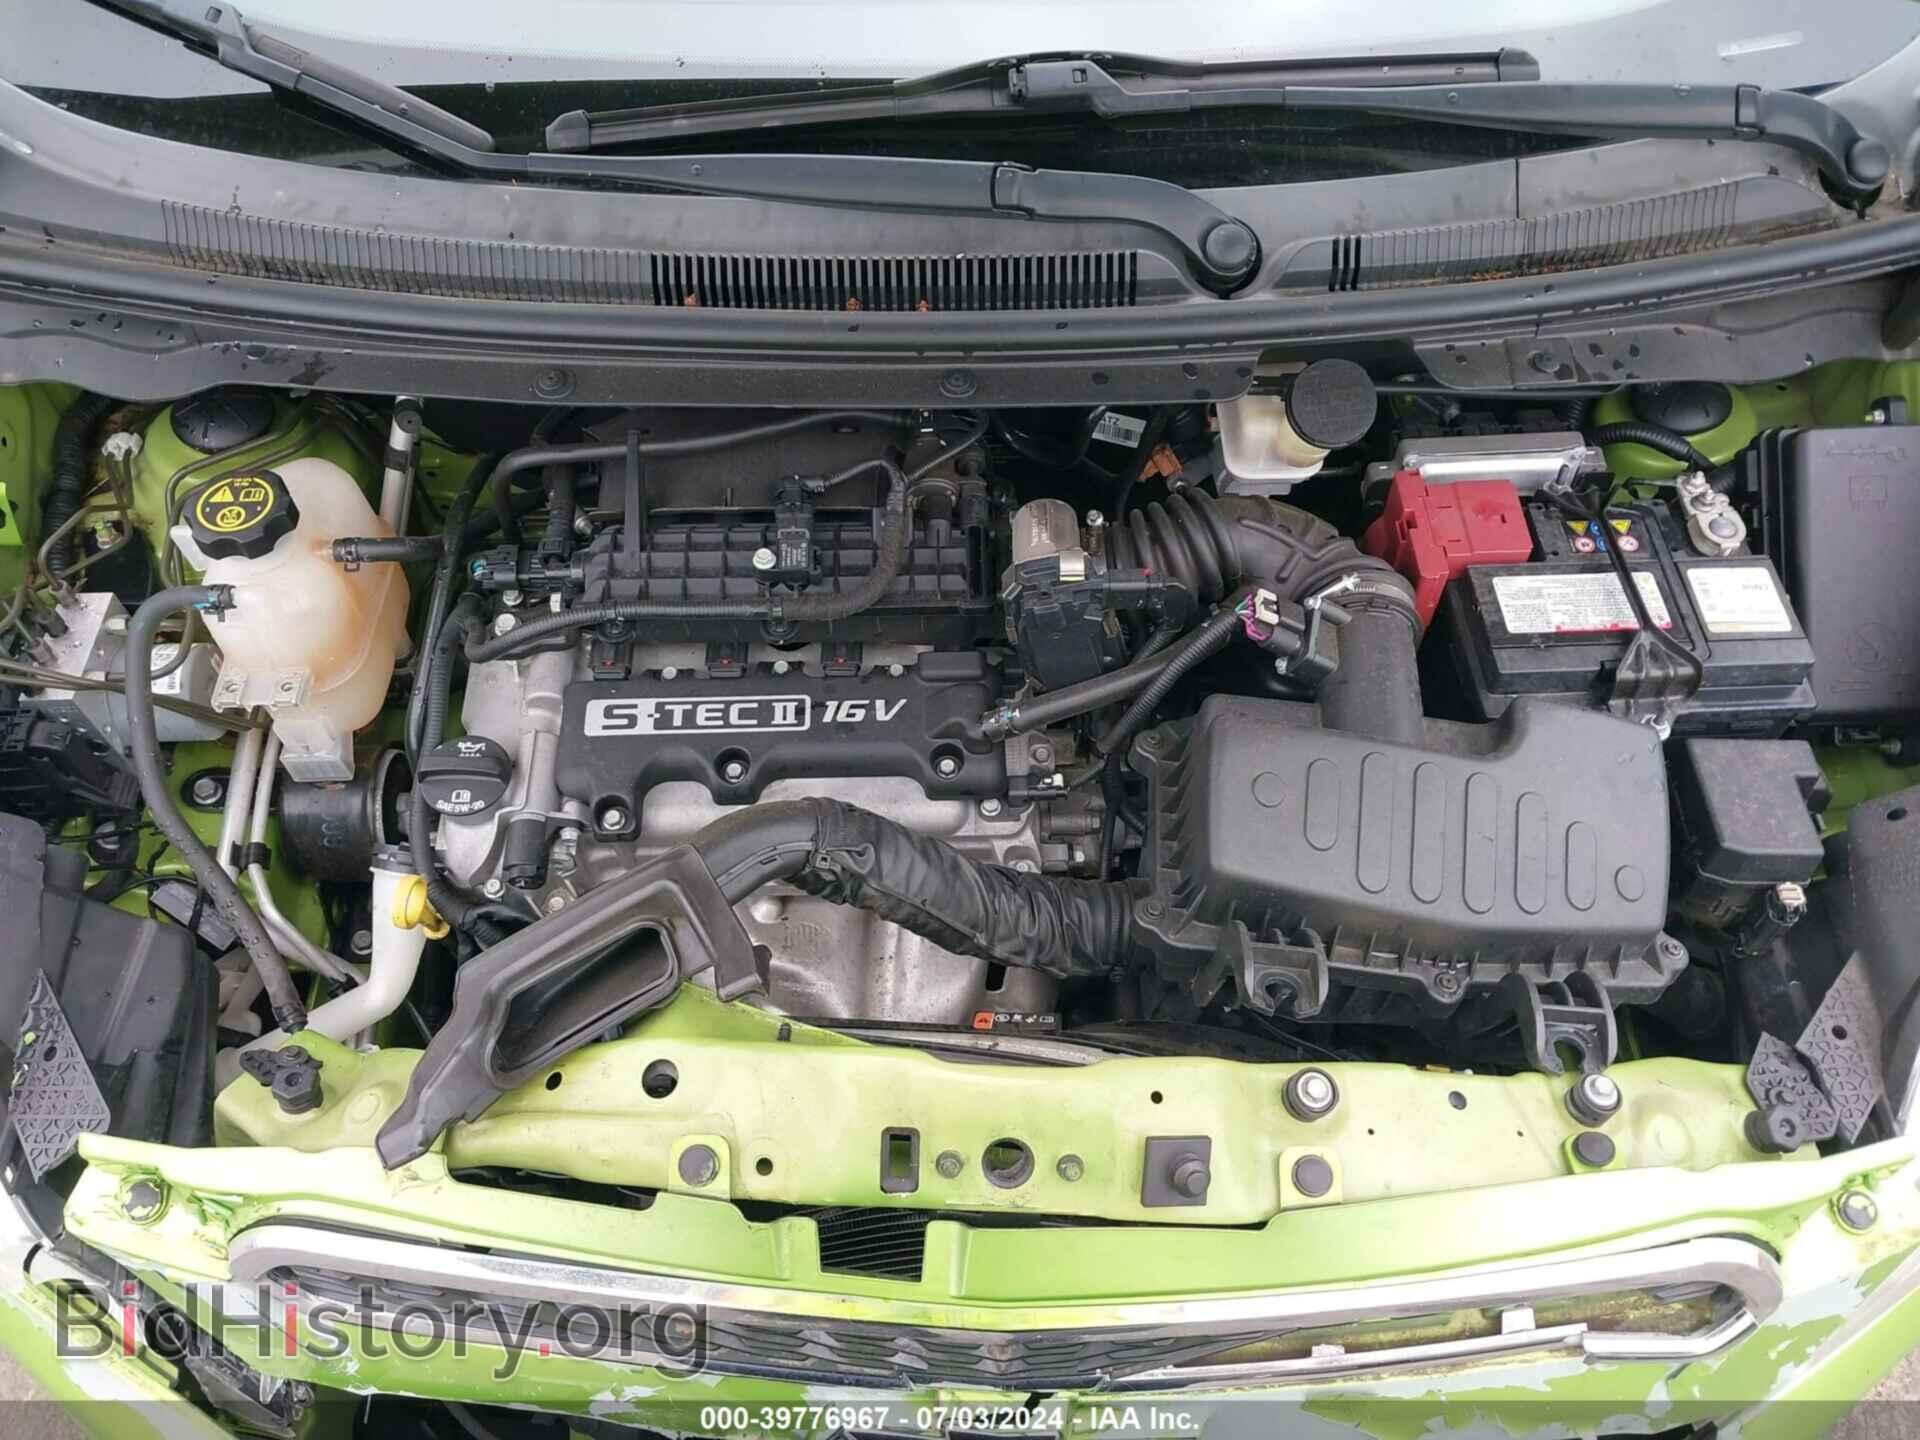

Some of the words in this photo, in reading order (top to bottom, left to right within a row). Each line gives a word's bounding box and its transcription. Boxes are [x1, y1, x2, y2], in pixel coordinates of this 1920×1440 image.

[601, 702, 759, 731] S-TEC
[770, 701, 799, 725] II
[821, 698, 907, 723] 16V
